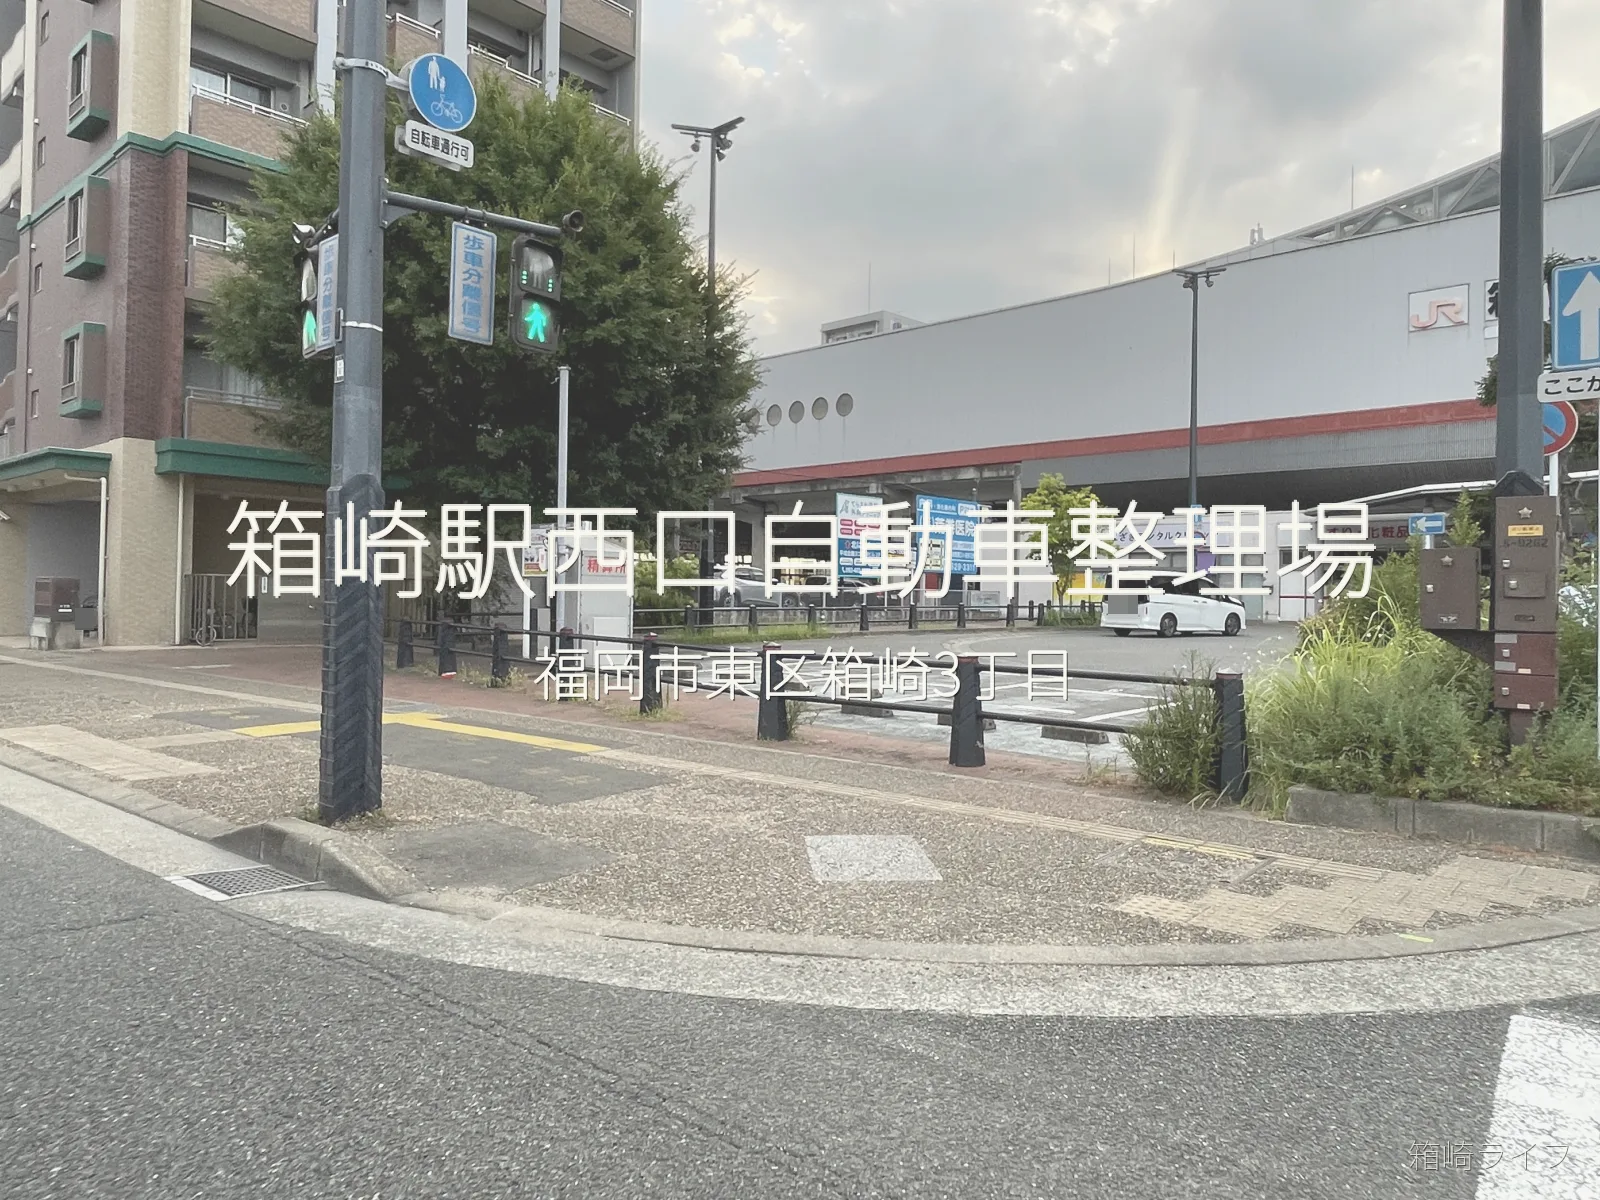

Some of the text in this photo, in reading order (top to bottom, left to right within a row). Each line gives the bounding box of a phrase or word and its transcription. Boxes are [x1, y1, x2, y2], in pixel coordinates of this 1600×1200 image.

[411, 128, 469, 162] 自転車通行可
[462, 234, 485, 333] 歩車分離信号
[1411, 300, 1465, 329] JR
